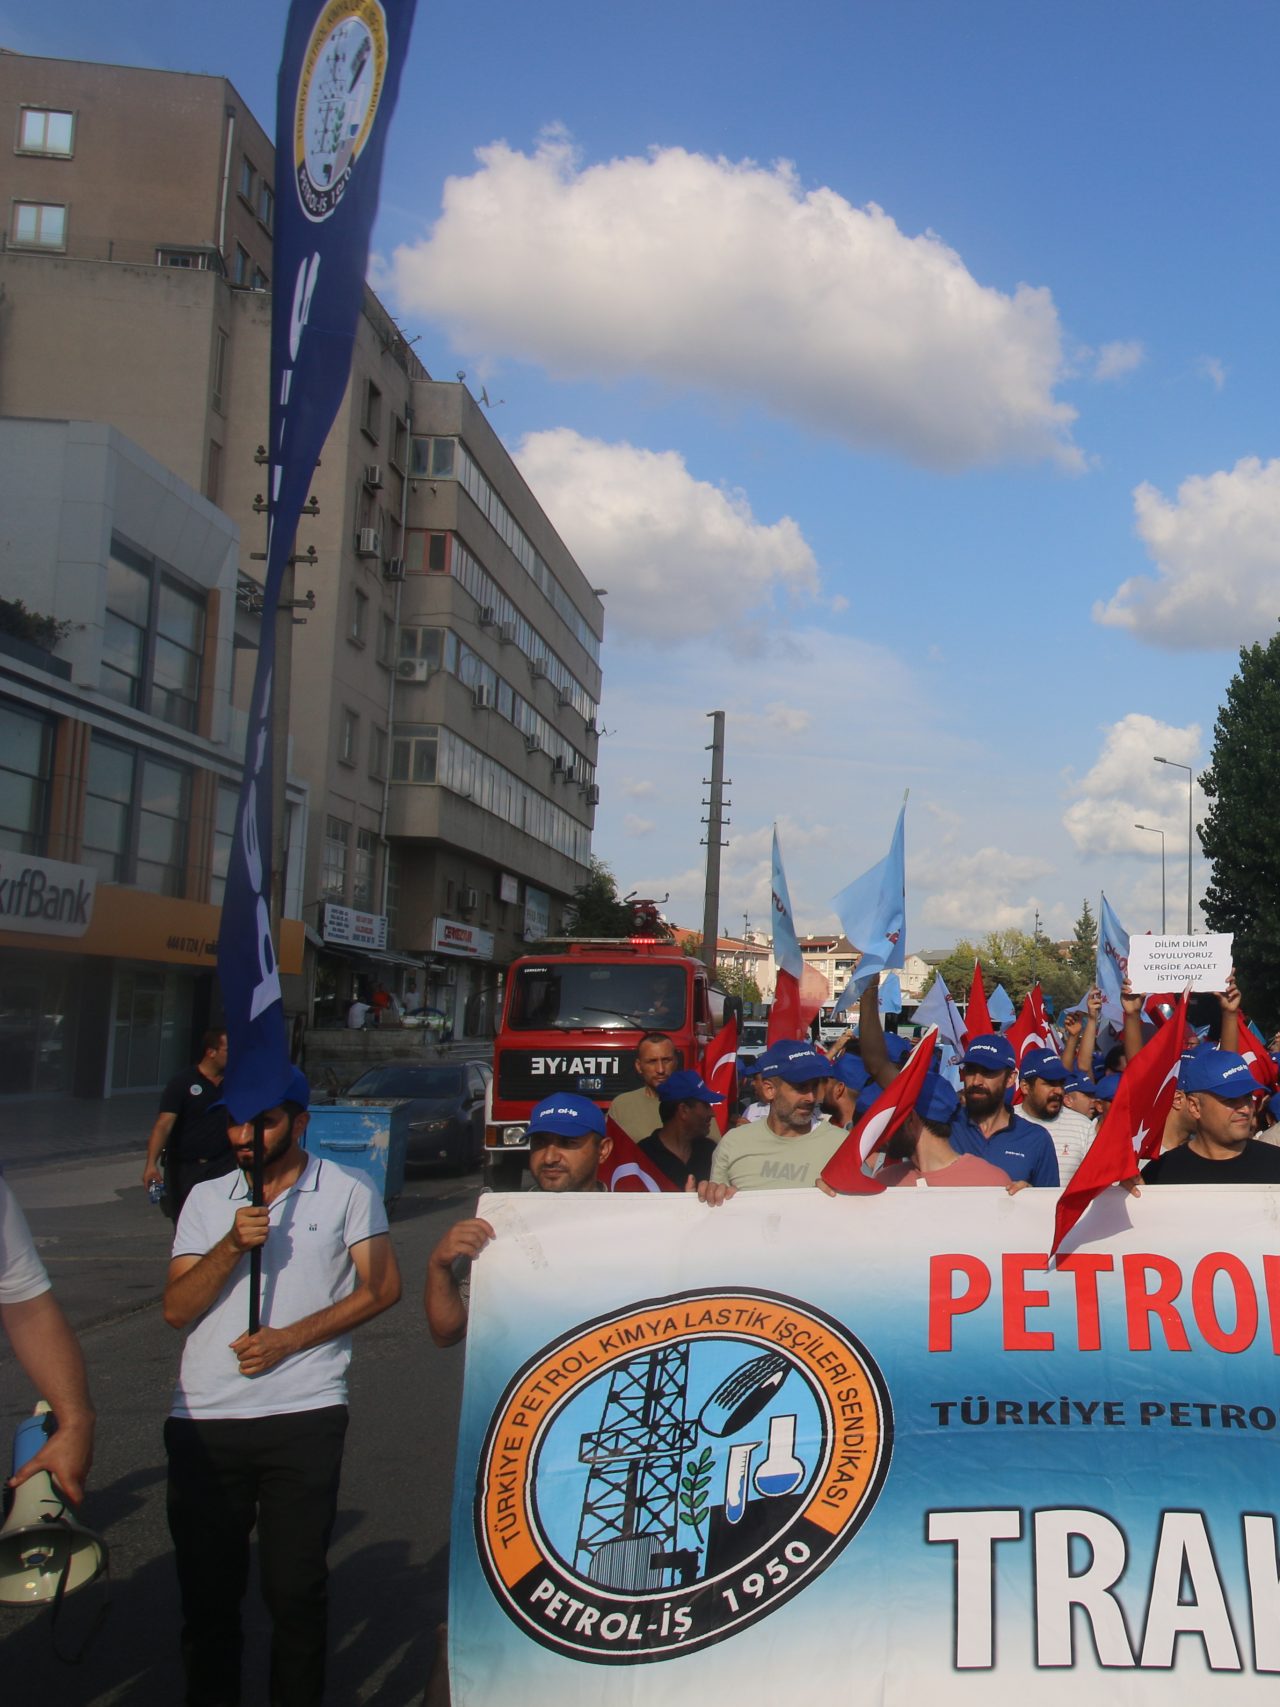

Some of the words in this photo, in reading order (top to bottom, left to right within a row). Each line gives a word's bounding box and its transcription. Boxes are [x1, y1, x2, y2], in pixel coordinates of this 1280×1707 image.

[1182, 940, 1208, 948] DİLİM
[760, 1160, 810, 1182] MAVİ
[931, 1396, 1126, 1426] TÜRKİYE
[494, 1435, 524, 1549] TÜRKİYE
[516, 1351, 597, 1429] PETROL
[599, 1317, 677, 1354] KİMYA
[685, 1306, 772, 1329] LASTİK
[771, 1315, 857, 1386] İŞÇİLERİ
[821, 1387, 862, 1508] SENDİKASI
[530, 1579, 693, 1641] PETROL-İŞ
[722, 1540, 811, 1613] 1950
